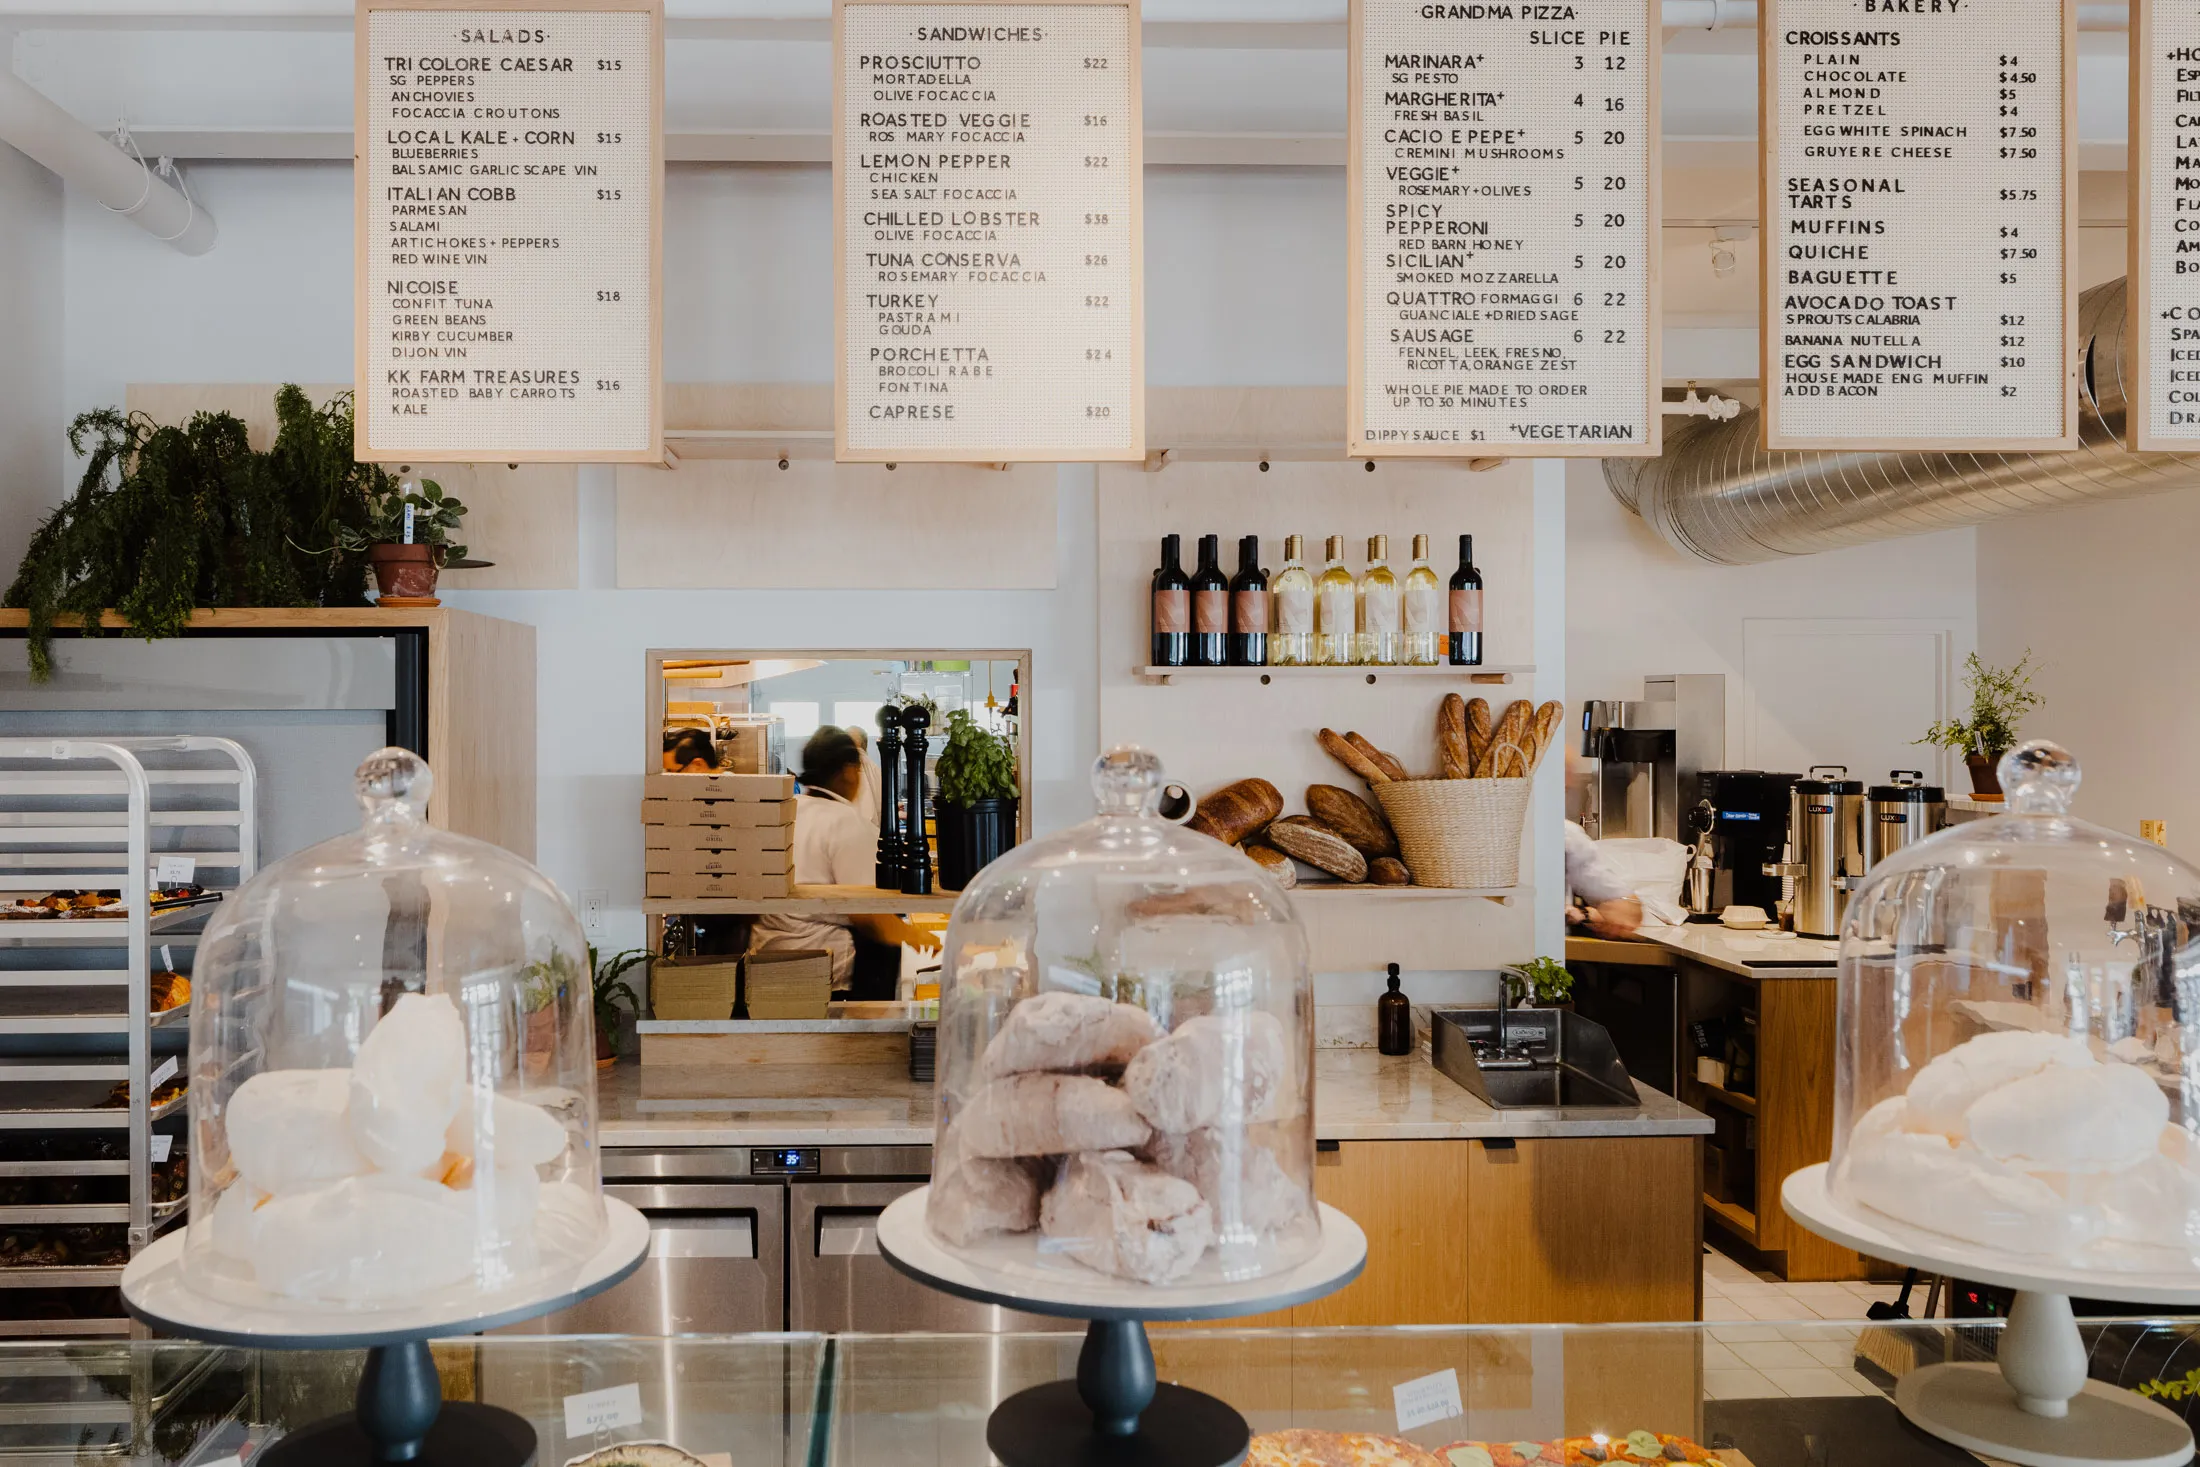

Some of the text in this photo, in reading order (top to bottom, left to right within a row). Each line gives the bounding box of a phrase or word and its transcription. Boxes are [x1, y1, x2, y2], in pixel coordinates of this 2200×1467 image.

[1530, 31, 1630, 45] SLICE PIE
[1786, 31, 1900, 46] CROISSANTS
[384, 57, 621, 71] TRI COLORE CAESAR $15
[861, 56, 1108, 70] PROSCIUTTO $22
[1804, 54, 1859, 65] PLAIN
[874, 74, 971, 84] MORTADELLA
[1804, 71, 2036, 83] CHOCOLATE $4.50
[392, 92, 474, 102] ANCHOVIES
[874, 91, 995, 101] OLIVE FOCACCIA
[1804, 88, 2016, 100] ALMOND $5
[393, 108, 559, 118] FOCACCIA CROUTONS
[1395, 110, 1484, 121] FRESH BASIL
[1805, 104, 1886, 115] PRETZEL
[861, 112, 1107, 127] ROASTED VEGGIE $16
[388, 130, 622, 144] LOCAL KALE CORN $15
[1805, 125, 2036, 138] EGG WHITE SPINACH $7.50
[393, 148, 478, 159] BLUEBERRIES
[1395, 148, 1564, 159] CREMINI MUSHROOMS
[1805, 146, 2036, 159] GRUYERE CHEESE $7.50
[861, 153, 1109, 168] LEMON PEPPER $22
[393, 165, 596, 175] BALSAMIC GARLIC SCAPE VIN
[870, 173, 937, 183] CHICKEN
[1788, 178, 1905, 193] SEASONAL
[388, 187, 621, 201] ITALIAN COBB $15
[871, 189, 1016, 199] SEA SALT FOCACCIA
[2000, 189, 2036, 200] $5.75
[1788, 195, 1851, 208] TARTS
[393, 205, 466, 215] PARMESAN
[1387, 204, 1442, 218] SPICY
[864, 211, 1039, 227] CHILLED LOBSTER
[1574, 214, 1624, 227] 5 20
[390, 221, 439, 231] SALAMI
[1387, 221, 1488, 235] PEPPERONI
[1792, 220, 1884, 234] MUFFINS
[391, 238, 559, 248] ARTICHOKES PEPPERS
[1399, 239, 1523, 250] RED BARN HONEY
[1789, 245, 2037, 260] QUICHE $7.50
[393, 254, 486, 264] RED WINE VIN
[866, 252, 1020, 267] TUNA CONSERVA
[1397, 273, 1558, 283] SMOKED MOZZARELLA
[1789, 270, 2016, 284] BAGUETTE $5
[388, 281, 458, 294] NICOISE
[597, 290, 620, 301] $18
[866, 294, 1109, 308] TURKEY $22
[1387, 292, 1625, 306] QUATTRO FORMAGGI 6 22
[392, 299, 493, 309] CONFIT TUNA
[1785, 296, 1957, 311] AVOCADO TOAST
[393, 315, 486, 325] GREEN BEANS
[1787, 314, 2024, 326] SPROUTS CALABRIA $12
[392, 331, 513, 341] KIRBY CUCUMBER
[879, 325, 931, 335] GOUDA
[1391, 329, 1625, 343] SAUSAGE 6 22
[1786, 335, 2024, 347] BANANA NUTELLA $12
[392, 347, 467, 357] DIJON VIN
[871, 348, 988, 361] PORCHETTA
[1785, 355, 2025, 368] EGG SANDWICH $10
[388, 370, 579, 384] KK FARM TREASURES
[1786, 373, 1988, 384] HOUSE MADE ENG MUFFIN
[596, 380, 619, 390] $16
[879, 382, 948, 392] FONTINA
[1385, 385, 1587, 395] WHOLE PIE MADE TO ORDER
[1785, 385, 2016, 397] ADD BACON $2
[392, 388, 575, 398] ROASTED BABY CARROTS
[392, 404, 427, 414] KALE
[869, 405, 1111, 419] CAPRESE $20
